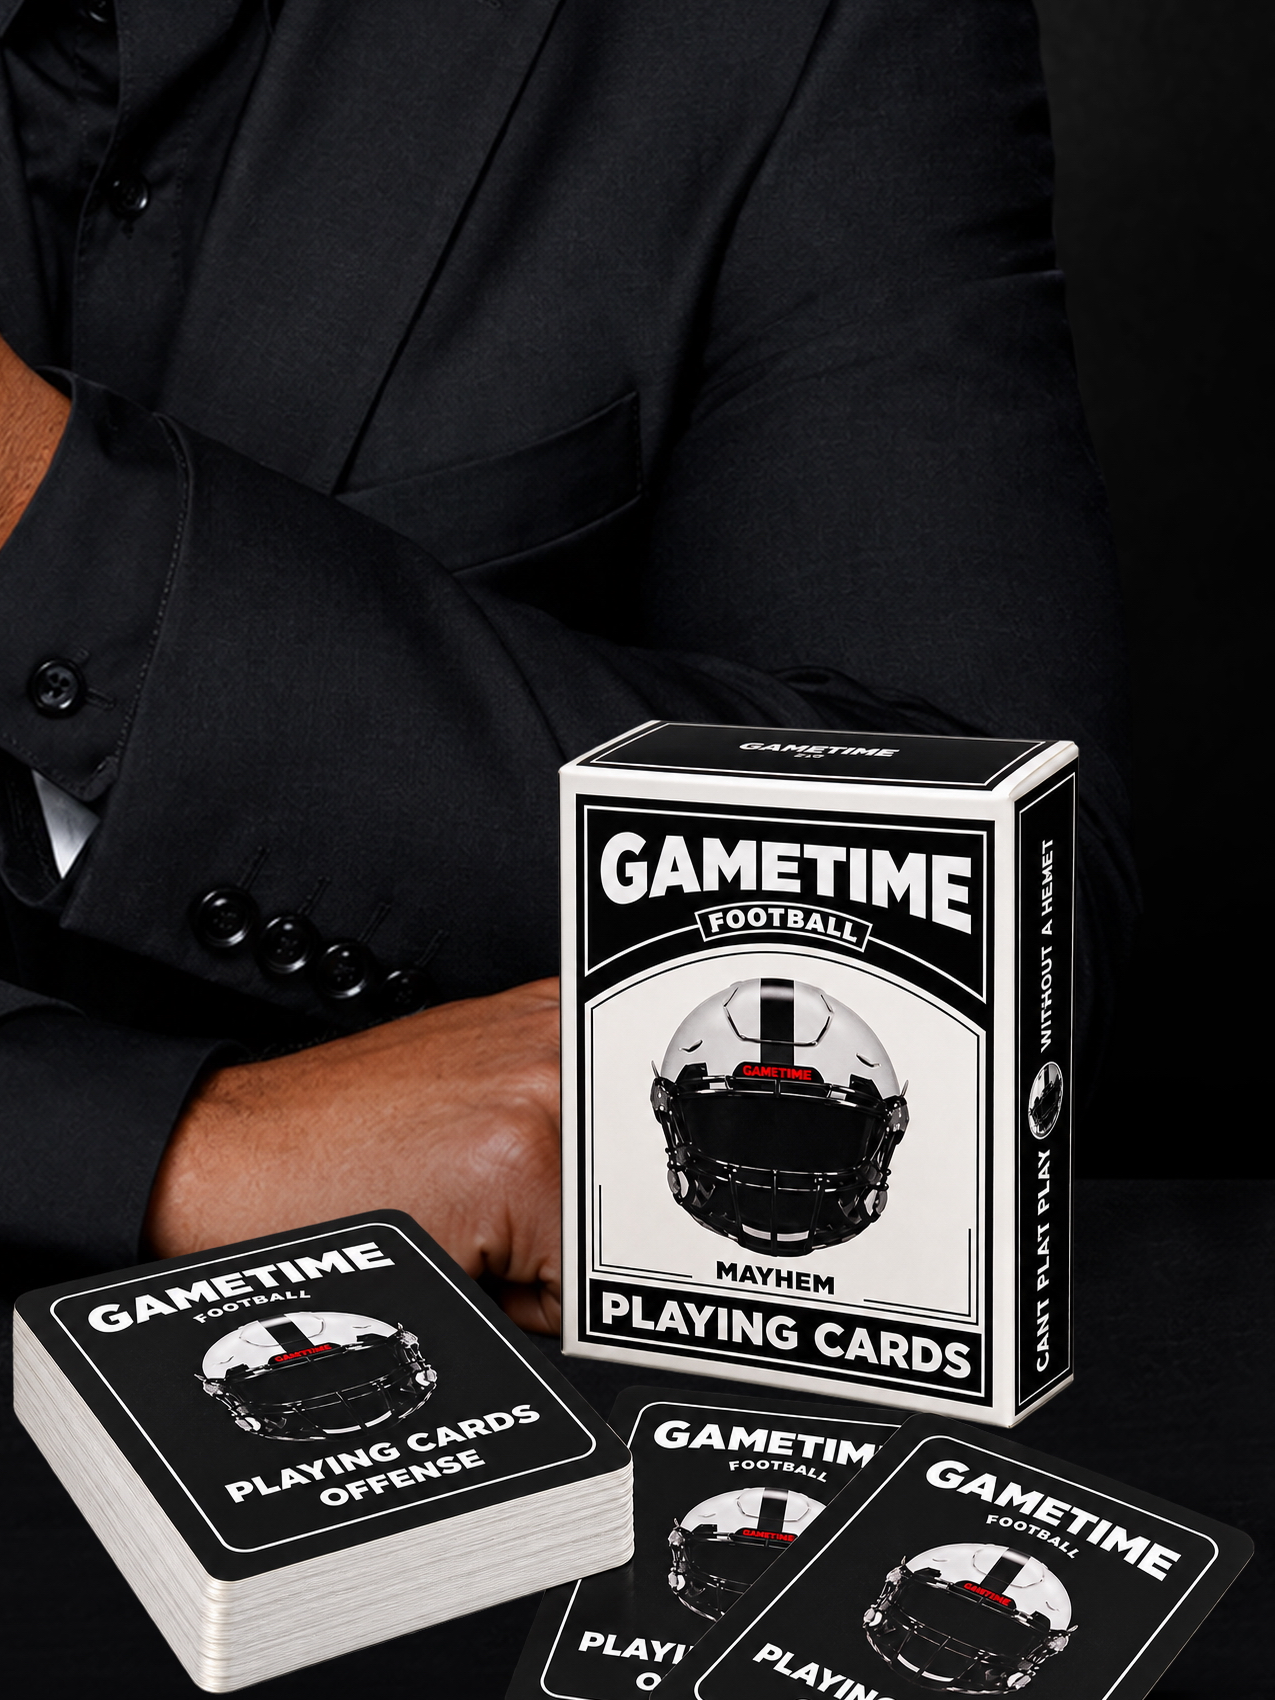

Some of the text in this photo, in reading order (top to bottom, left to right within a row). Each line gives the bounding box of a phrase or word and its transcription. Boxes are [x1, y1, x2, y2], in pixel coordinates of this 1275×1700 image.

[739, 742, 900, 758] GAMETIME
[600, 831, 972, 935] GAMETIME
[710, 907, 857, 943] FOOTBALL
[1041, 918, 1053, 935] A
[1040, 945, 1053, 1053] WITHOUT
[742, 1065, 813, 1080] GAMETIME
[1038, 1149, 1051, 1216] PLAY
[716, 1261, 835, 1295] MAYHEM
[1037, 1222, 1050, 1291] PLAT
[88, 1241, 395, 1333] GAMETIME
[193, 1290, 311, 1324] FOOTBALL
[602, 1291, 972, 1379] PLAYING CARDS
[1036, 1298, 1050, 1372] CANT
[225, 1404, 540, 1503] PLAYING CARDS
[654, 1419, 882, 1469] GAMETIM
[729, 1460, 827, 1482] FOOTBALL
[320, 1449, 486, 1506] OFFENSE
[926, 1460, 1181, 1582] GAMETIME
[986, 1514, 1079, 1559] FOOTBALL
